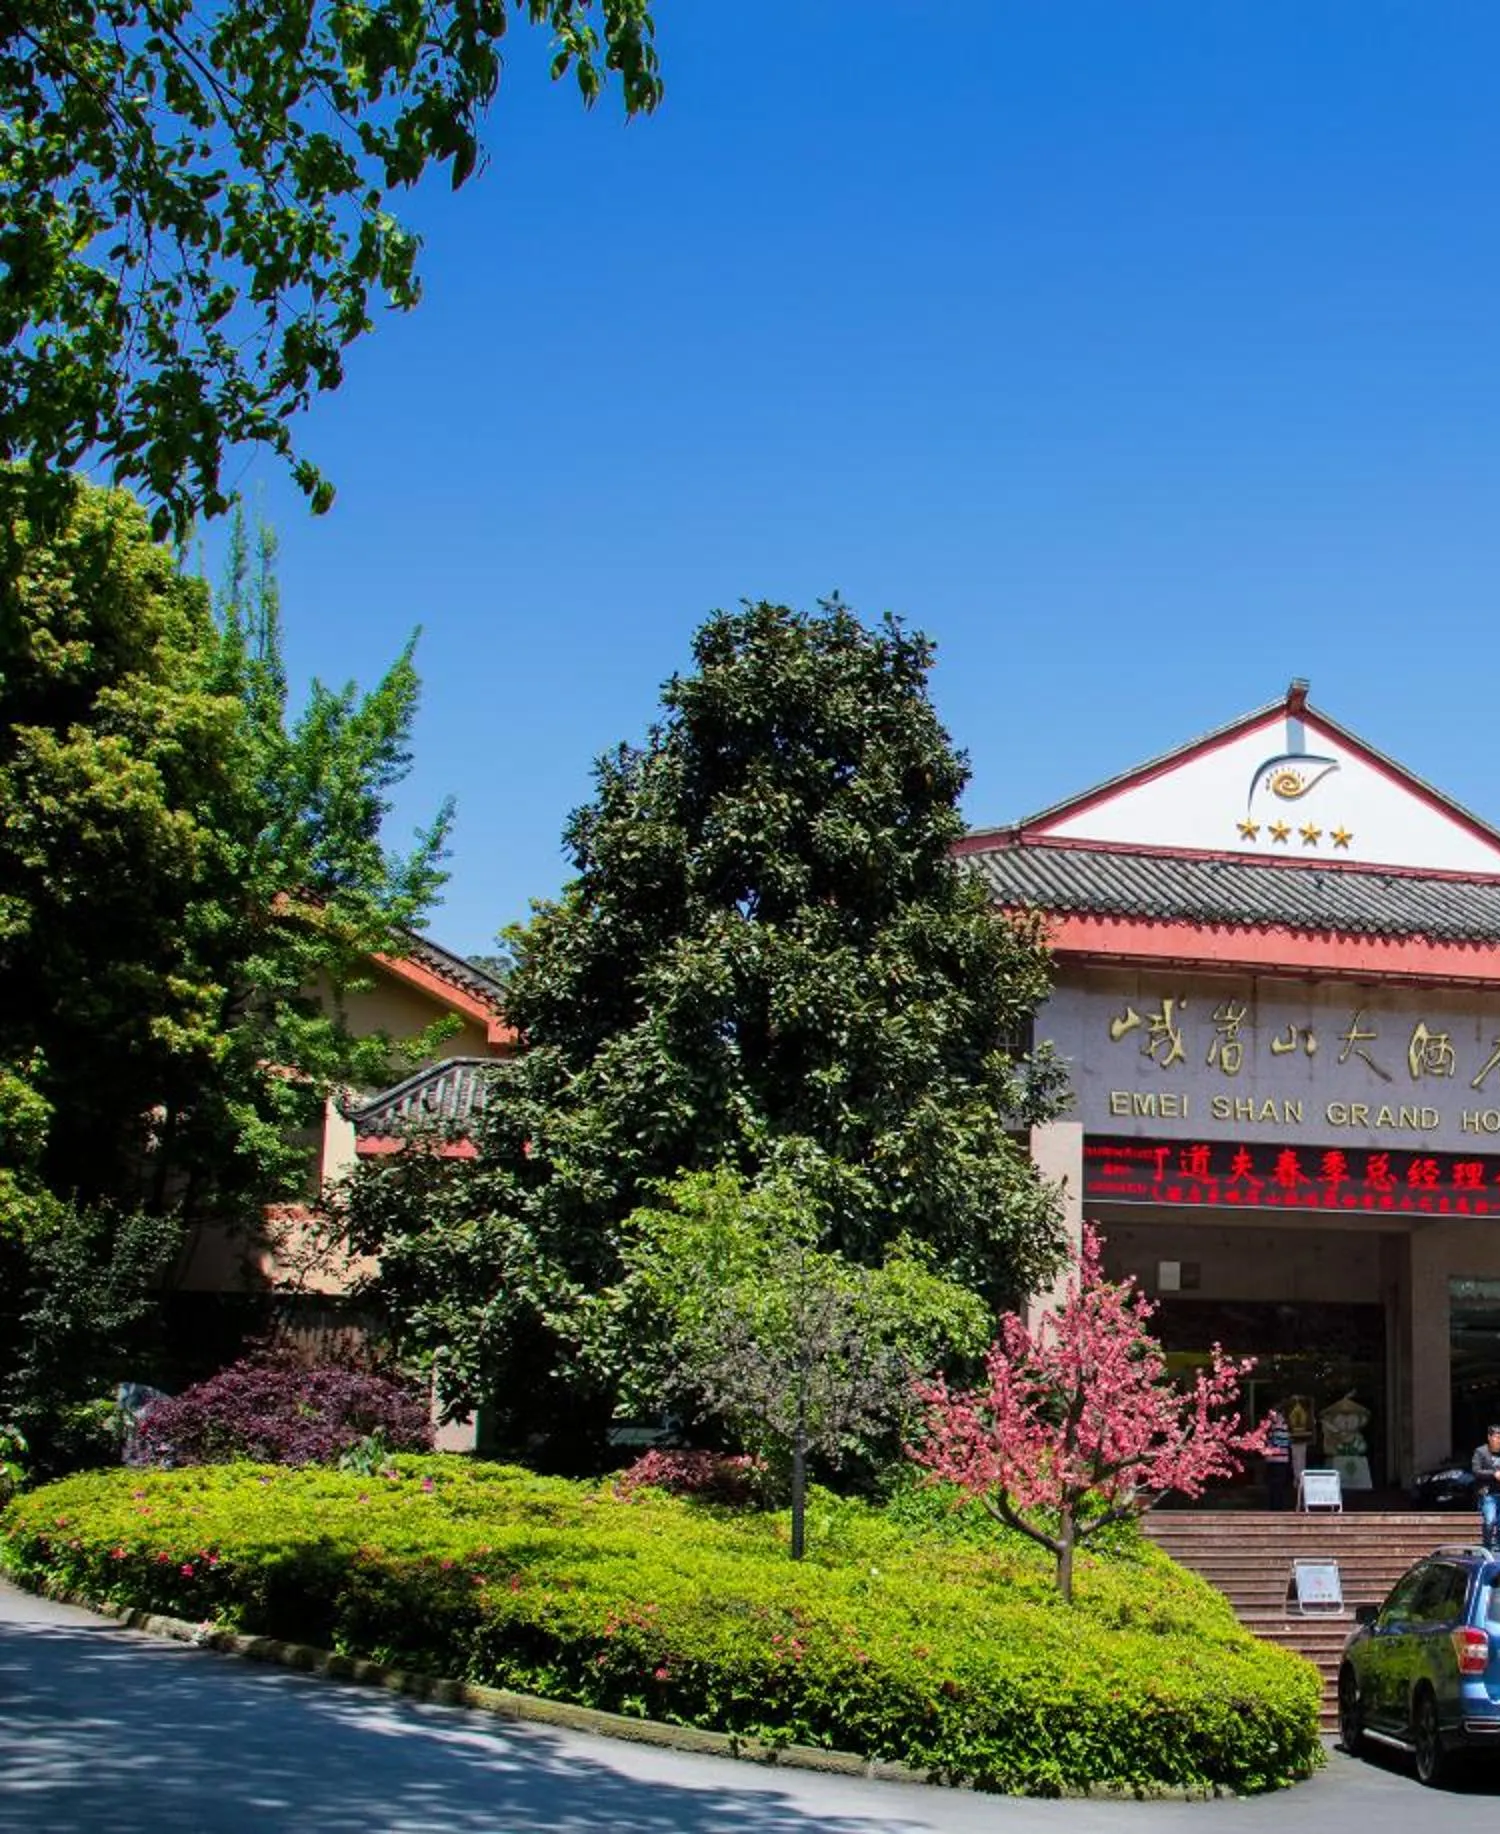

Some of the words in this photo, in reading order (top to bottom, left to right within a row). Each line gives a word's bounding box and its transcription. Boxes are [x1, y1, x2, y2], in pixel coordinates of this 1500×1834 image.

[1110, 1090, 1189, 1119] EMEI
[1212, 1095, 1304, 1124] SHAN
[1327, 1102, 1440, 1131] GRAND
